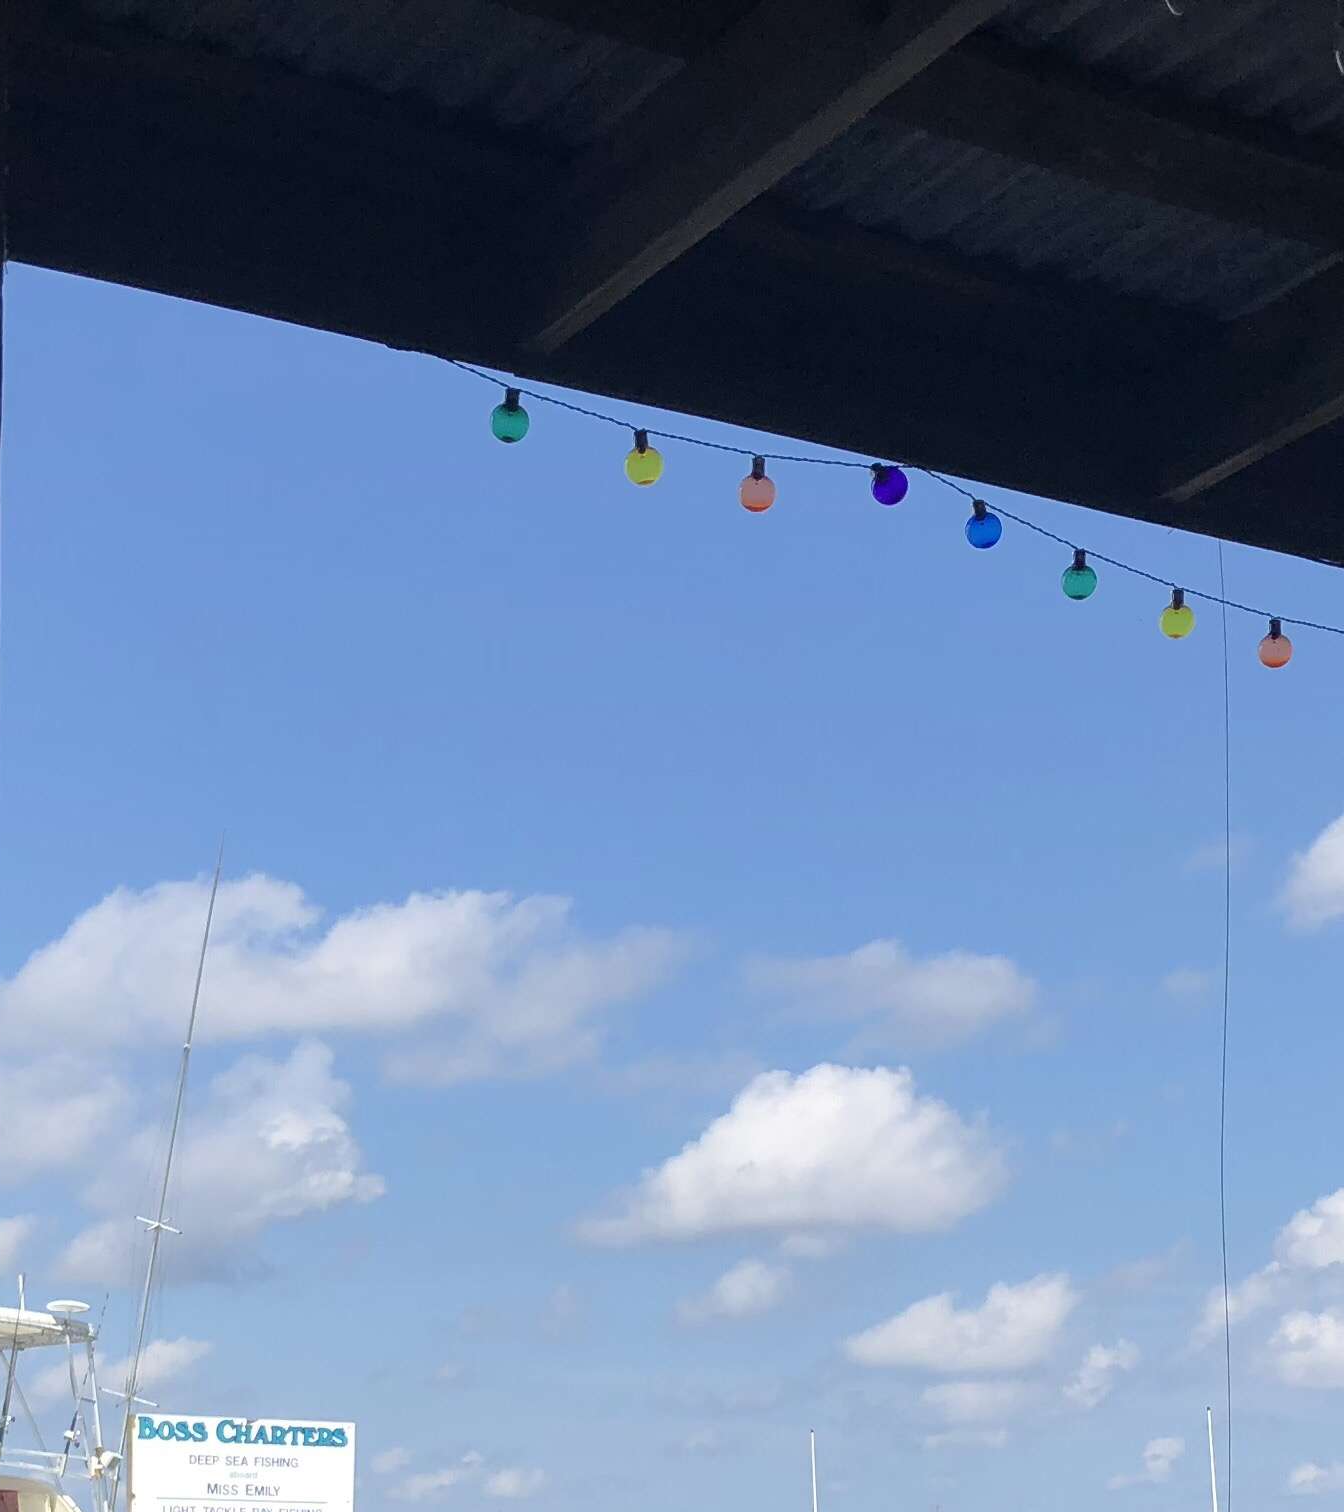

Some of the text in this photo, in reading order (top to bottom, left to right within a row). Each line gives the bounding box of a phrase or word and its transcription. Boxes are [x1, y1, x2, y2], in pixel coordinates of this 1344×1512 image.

[188, 1454, 299, 1468] DEEP SEA FISHING
[206, 1483, 281, 1497] MISS EMILY
